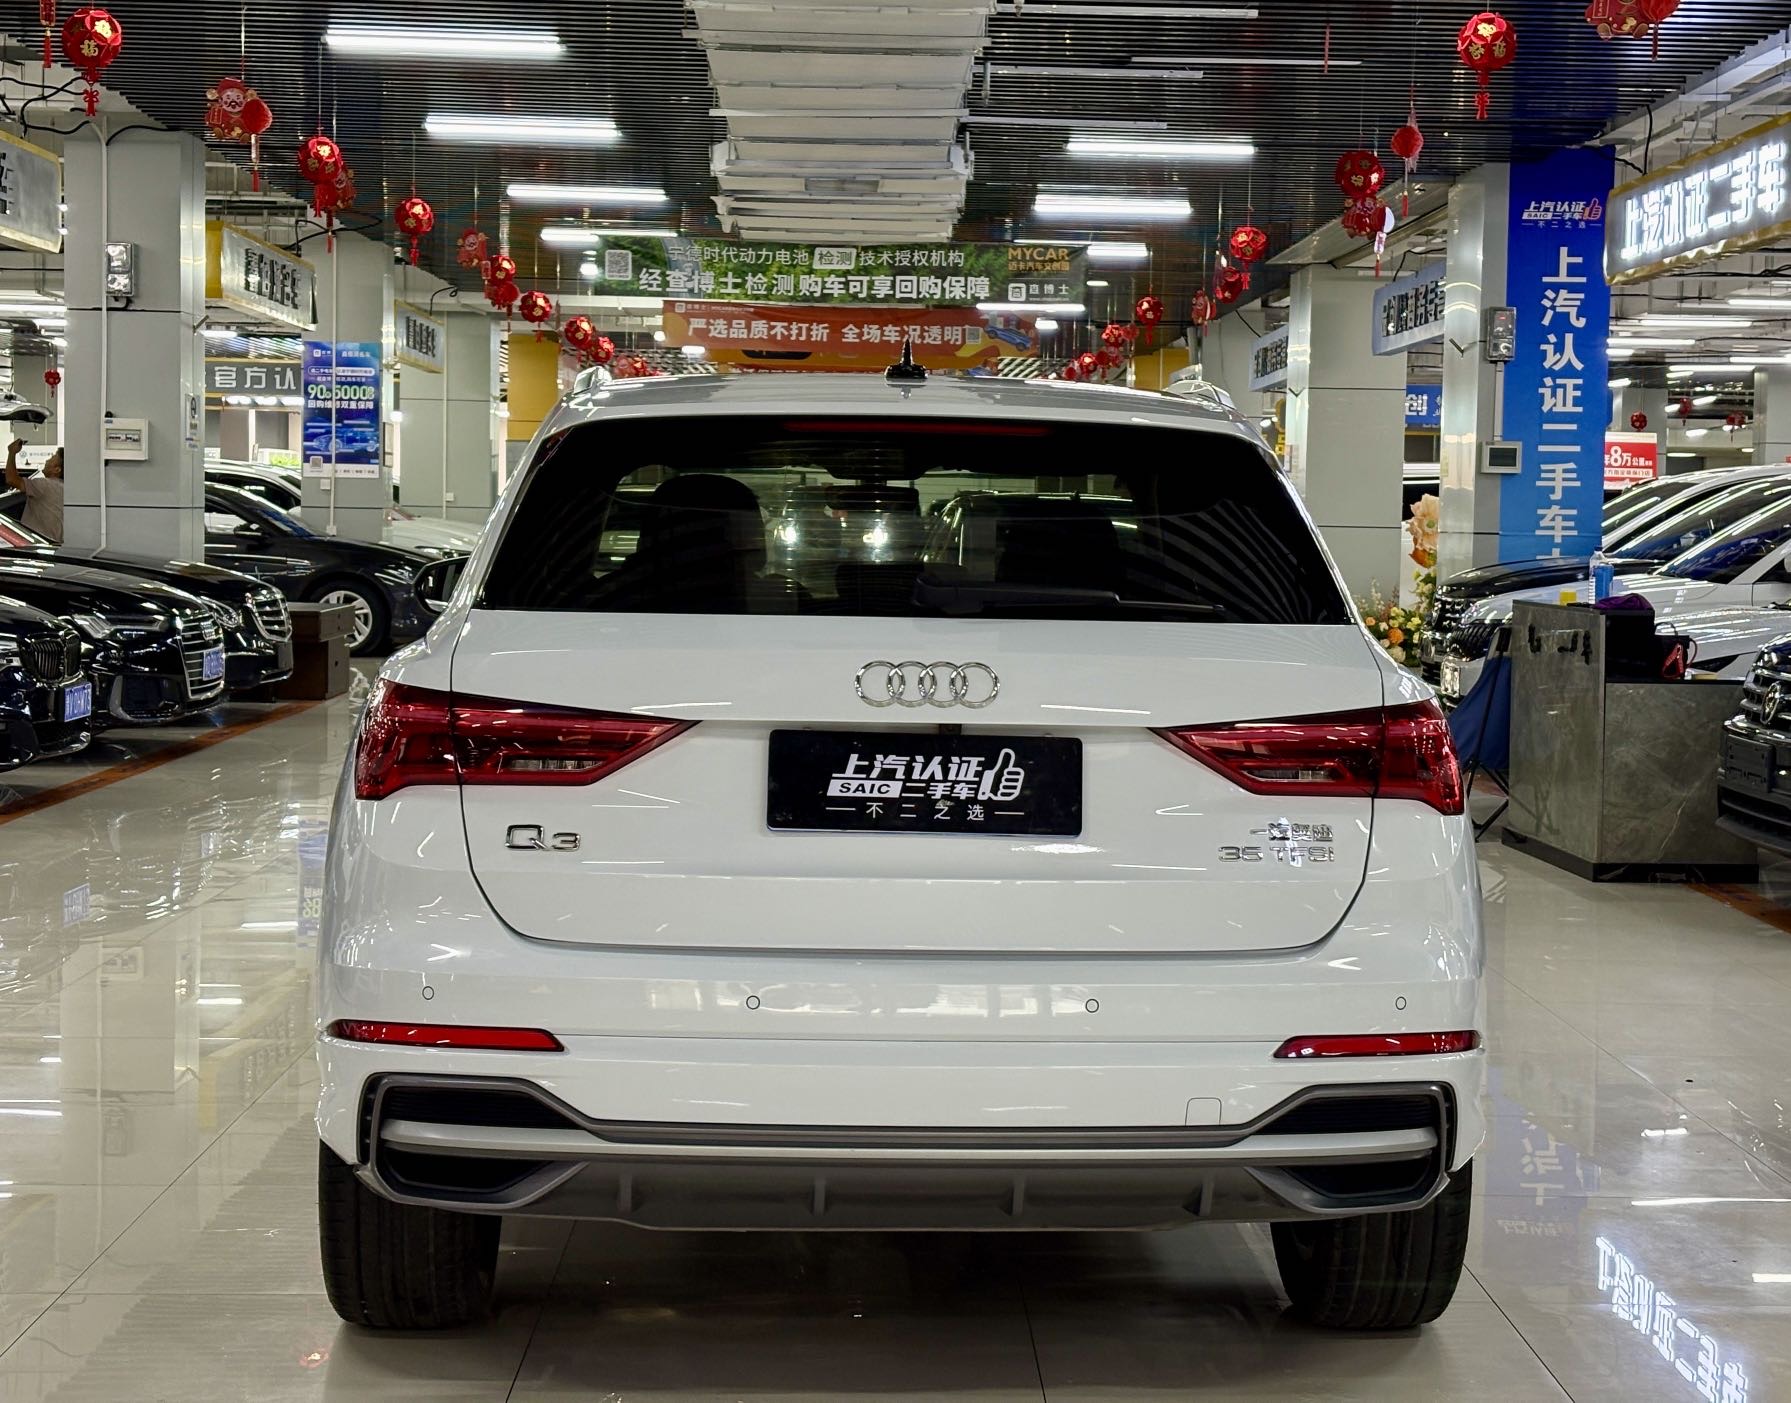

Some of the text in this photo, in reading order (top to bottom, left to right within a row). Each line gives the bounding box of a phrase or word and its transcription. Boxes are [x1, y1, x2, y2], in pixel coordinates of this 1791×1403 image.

[1524, 201, 1587, 212] 上汽认证
[1620, 142, 1786, 259] 上汽认证二手车
[668, 246, 965, 267] 宁德时代动力电池 检测 技术授权机构
[1008, 247, 1069, 260] MYCAR
[639, 268, 990, 300] 经查博士检测购车可享回购保障
[688, 317, 963, 345] 严选品质不打折 全场车况透明
[204, 366, 296, 389] 官方认
[832, 754, 985, 781] 上汽认证
[838, 782, 978, 800] SAIC 二手车
[866, 802, 985, 821] 不二之选
[505, 824, 581, 852] Q3
[1219, 846, 1335, 862] 35 TFSI
